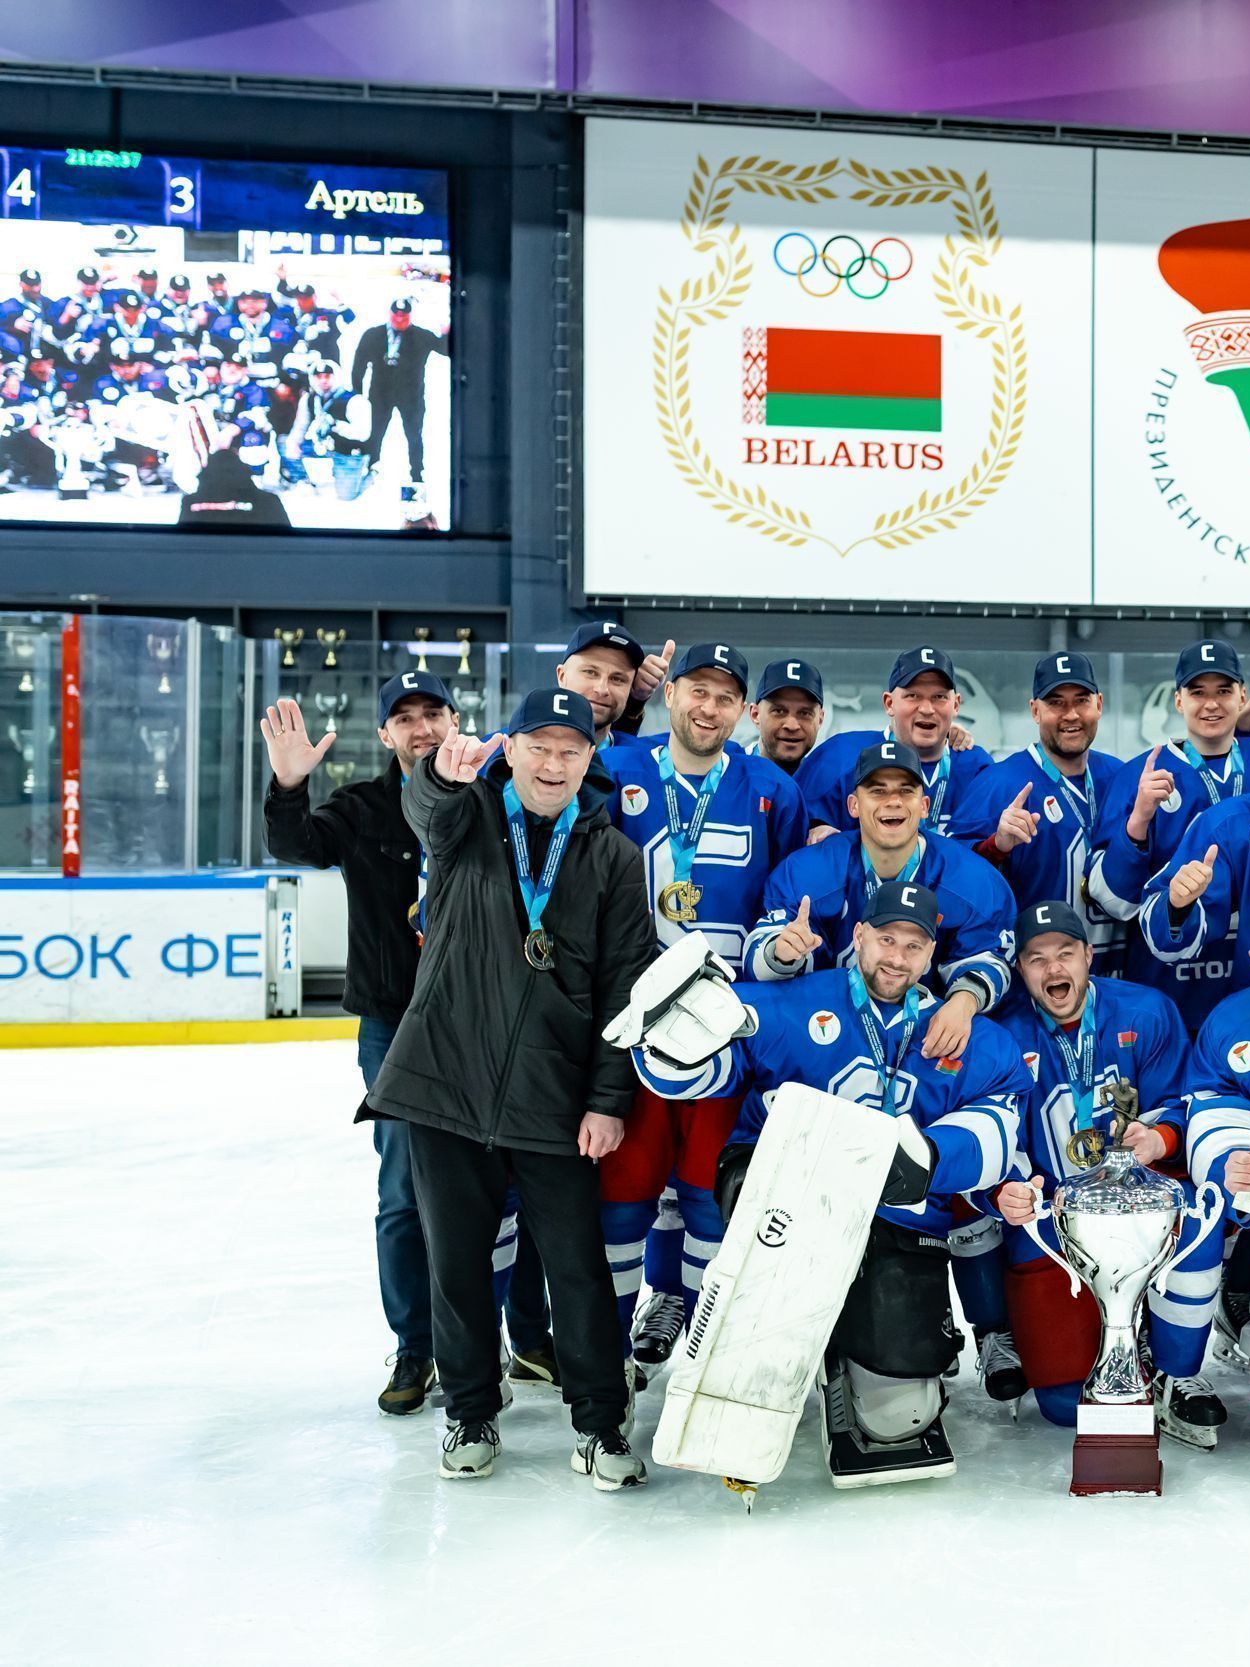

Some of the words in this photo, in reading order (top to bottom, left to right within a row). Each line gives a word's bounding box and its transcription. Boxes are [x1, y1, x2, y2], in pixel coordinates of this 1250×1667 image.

[6, 168, 36, 206] 4
[169, 176, 195, 214] 3
[304, 180, 425, 220] Артель
[742, 436, 944, 471] BELARUS
[63, 779, 80, 855] RAITA
[0, 934, 132, 979] БОК
[160, 933, 262, 978] ФЕ
[281, 911, 293, 971] RAITA
[686, 1280, 721, 1361] WARRIOR
